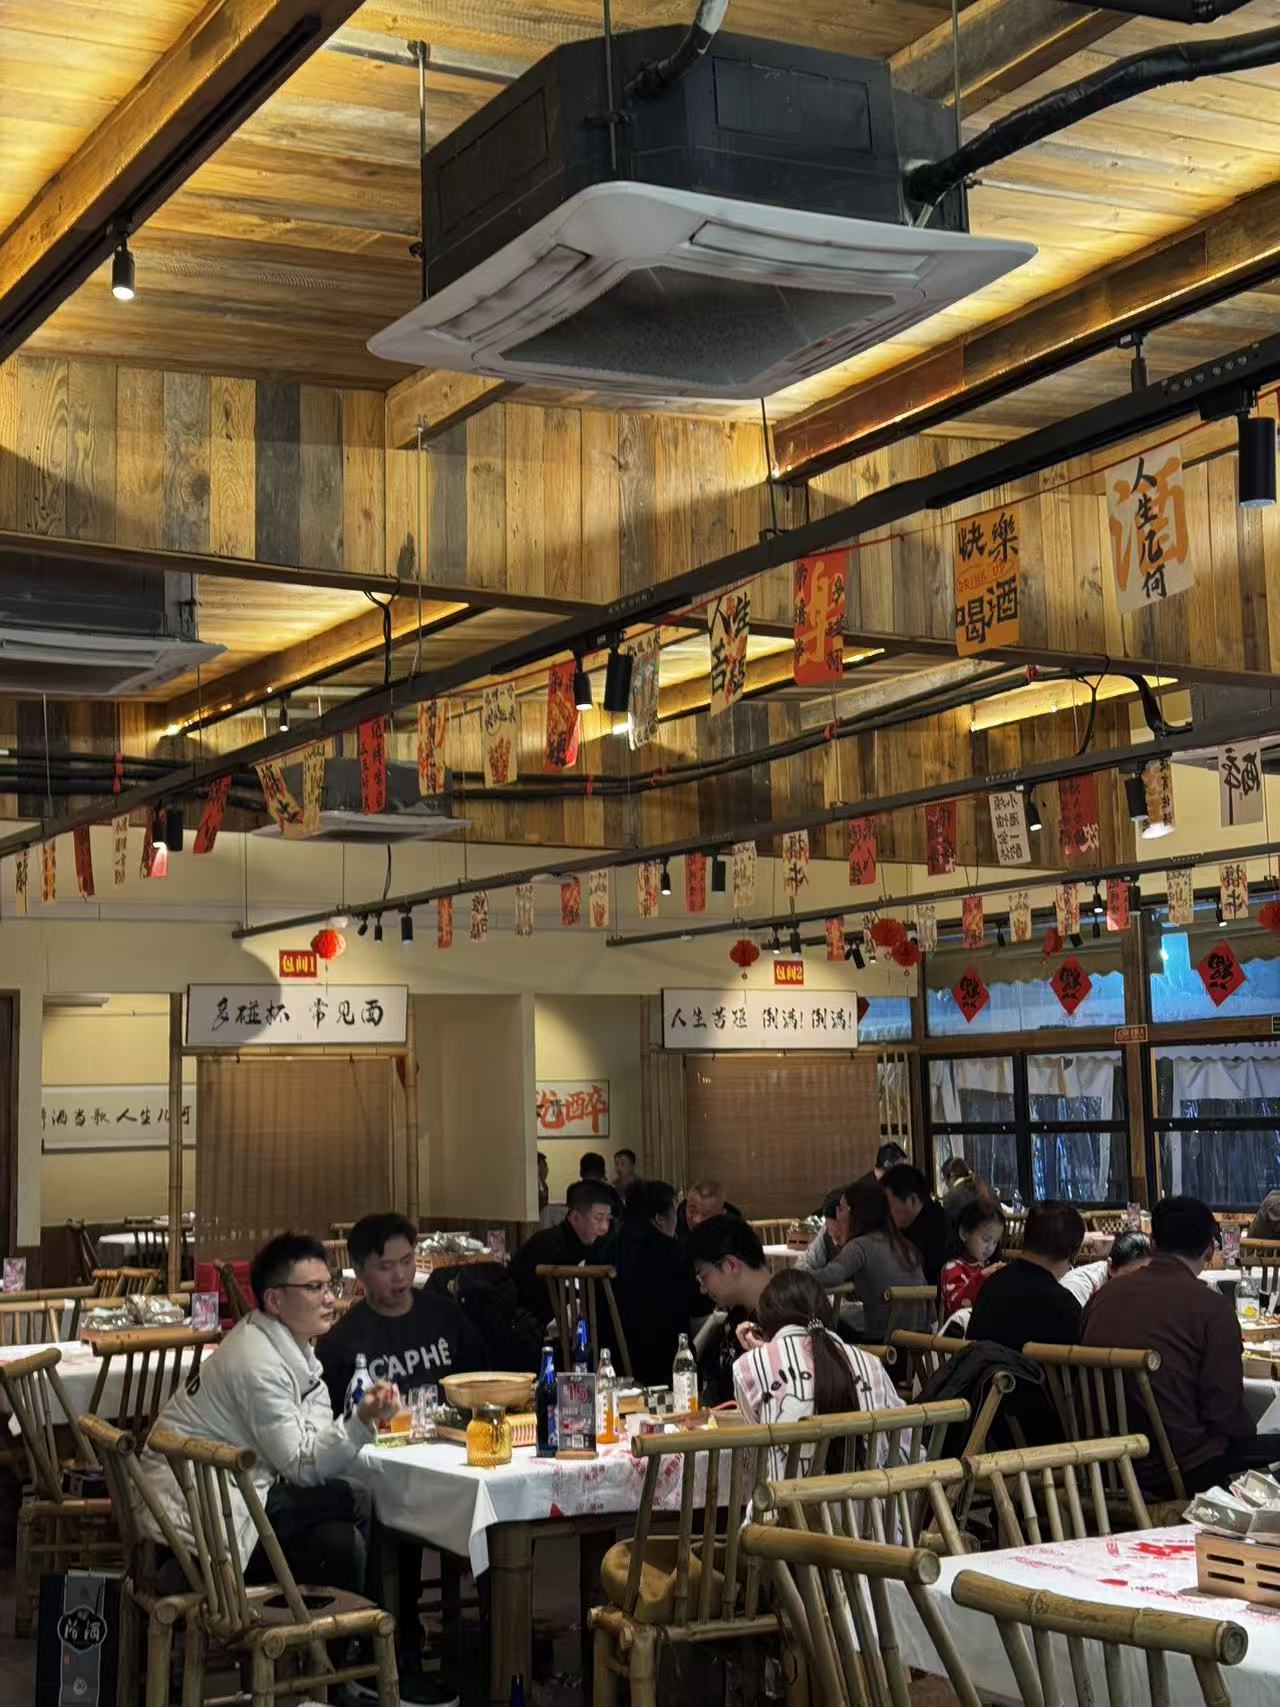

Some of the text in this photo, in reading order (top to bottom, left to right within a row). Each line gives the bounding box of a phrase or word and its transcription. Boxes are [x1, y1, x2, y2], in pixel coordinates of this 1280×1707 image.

[957, 511, 1018, 562] 快樂
[1131, 456, 1168, 599] 人生几何
[956, 574, 1018, 643] 喝酒
[211, 996, 384, 1032] 多碰杯 常见面
[671, 1006, 748, 1031] 人生苦短
